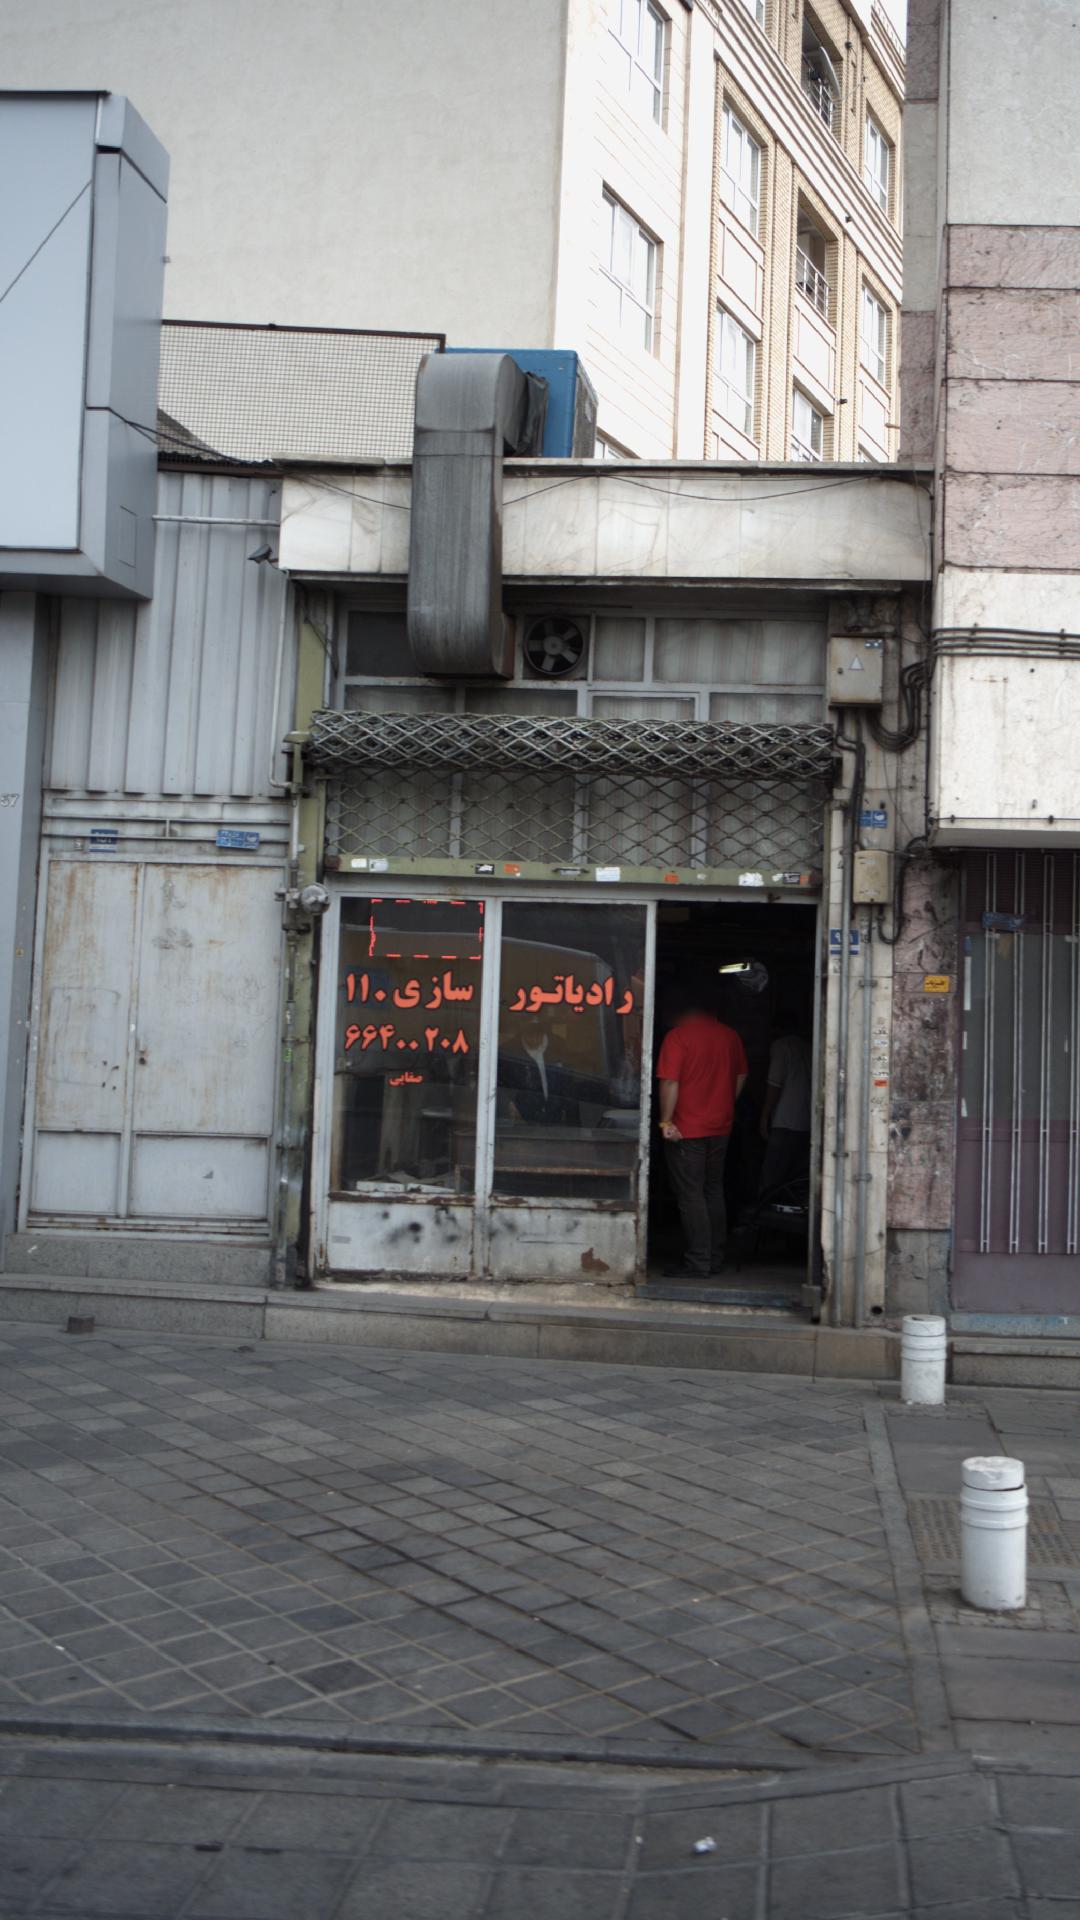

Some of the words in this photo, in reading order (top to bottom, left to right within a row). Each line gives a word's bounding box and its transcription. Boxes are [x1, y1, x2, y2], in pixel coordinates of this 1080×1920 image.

[346, 974, 387, 1002] ۱۱۰
[393, 971, 474, 1009] سازی
[509, 975, 635, 1015] رادیاتور
